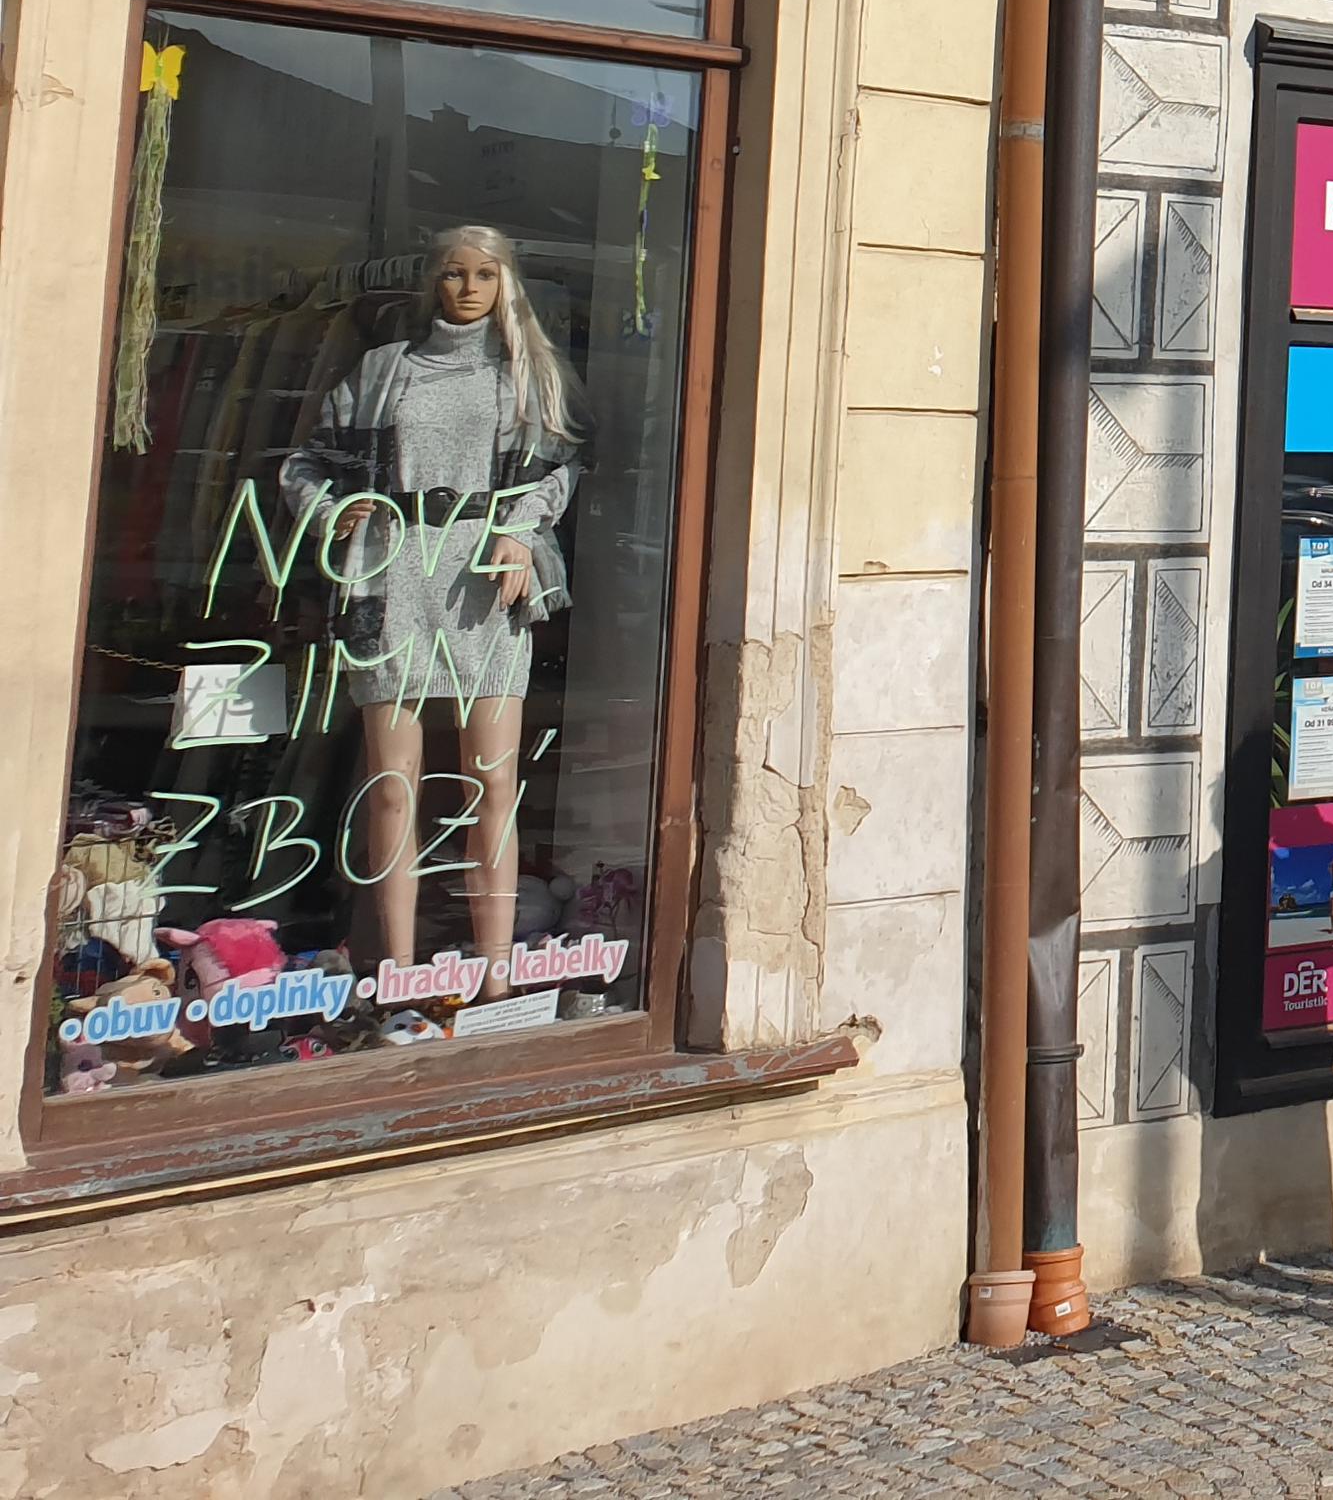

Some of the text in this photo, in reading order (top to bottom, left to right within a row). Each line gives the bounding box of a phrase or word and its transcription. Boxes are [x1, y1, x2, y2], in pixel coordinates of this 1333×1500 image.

[204, 443, 540, 621] NOVÉ
[171, 586, 561, 750] ZIMNÍ
[141, 728, 558, 912] ZBOŽÍ
[88, 934, 629, 1041] obuv doplňky hračky kabelky
[1283, 995, 1328, 1011] Touristik
